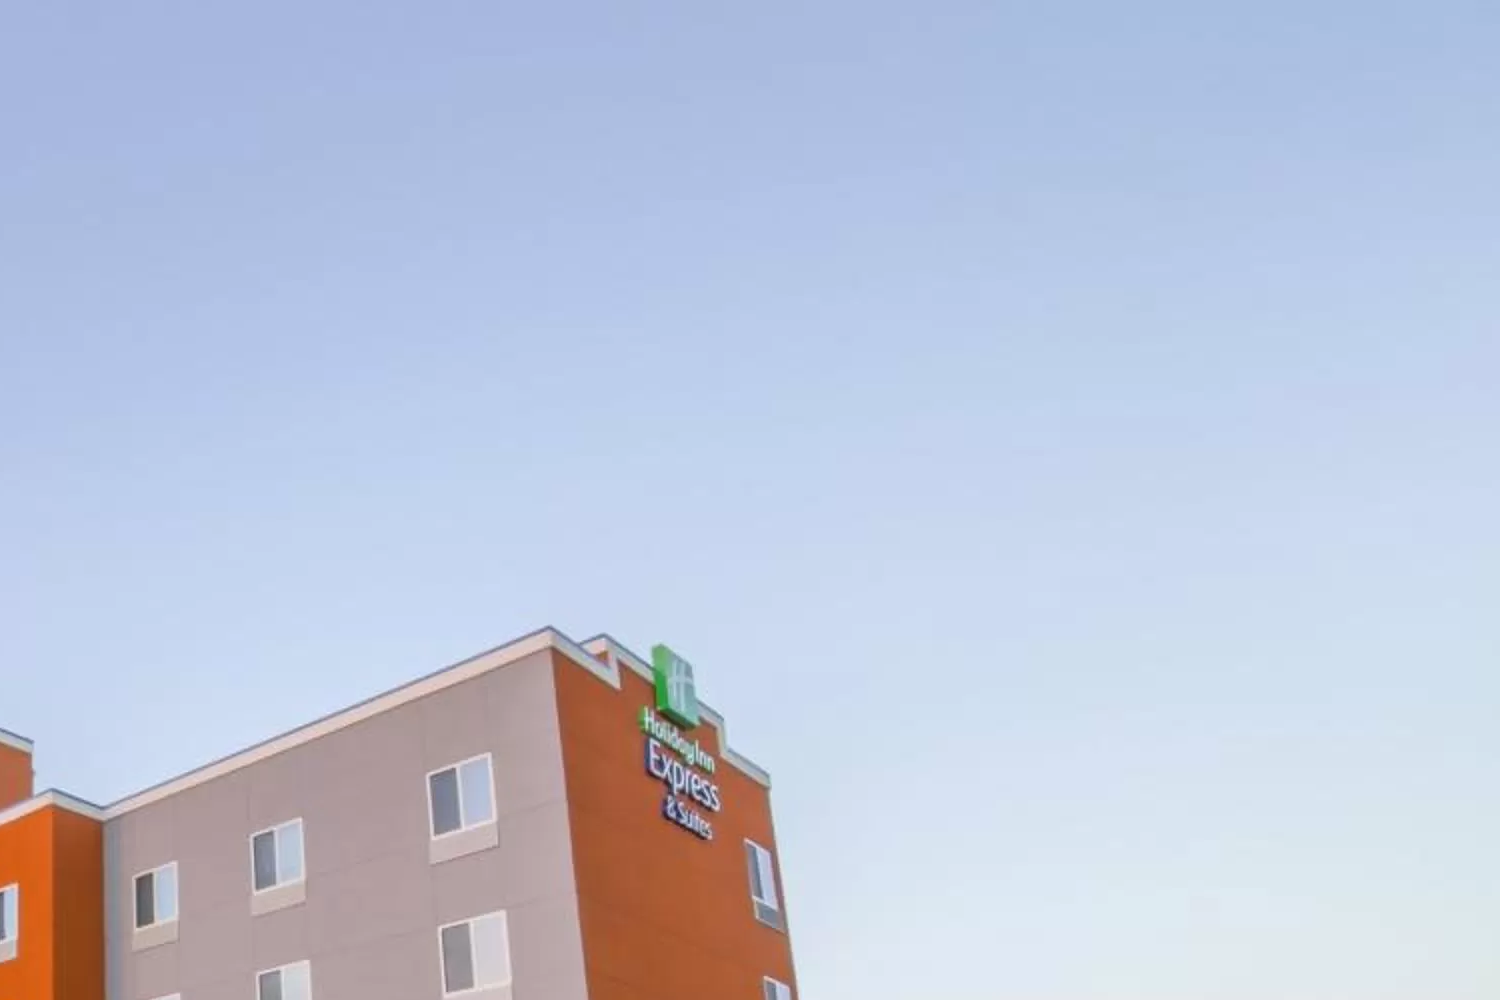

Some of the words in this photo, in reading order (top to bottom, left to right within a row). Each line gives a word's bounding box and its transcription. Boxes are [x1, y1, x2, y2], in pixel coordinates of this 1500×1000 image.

[640, 705, 695, 765] Holiday
[694, 740, 716, 772] Inn
[647, 737, 722, 812] Express
[663, 796, 676, 820] &
[676, 802, 713, 840] Suites
